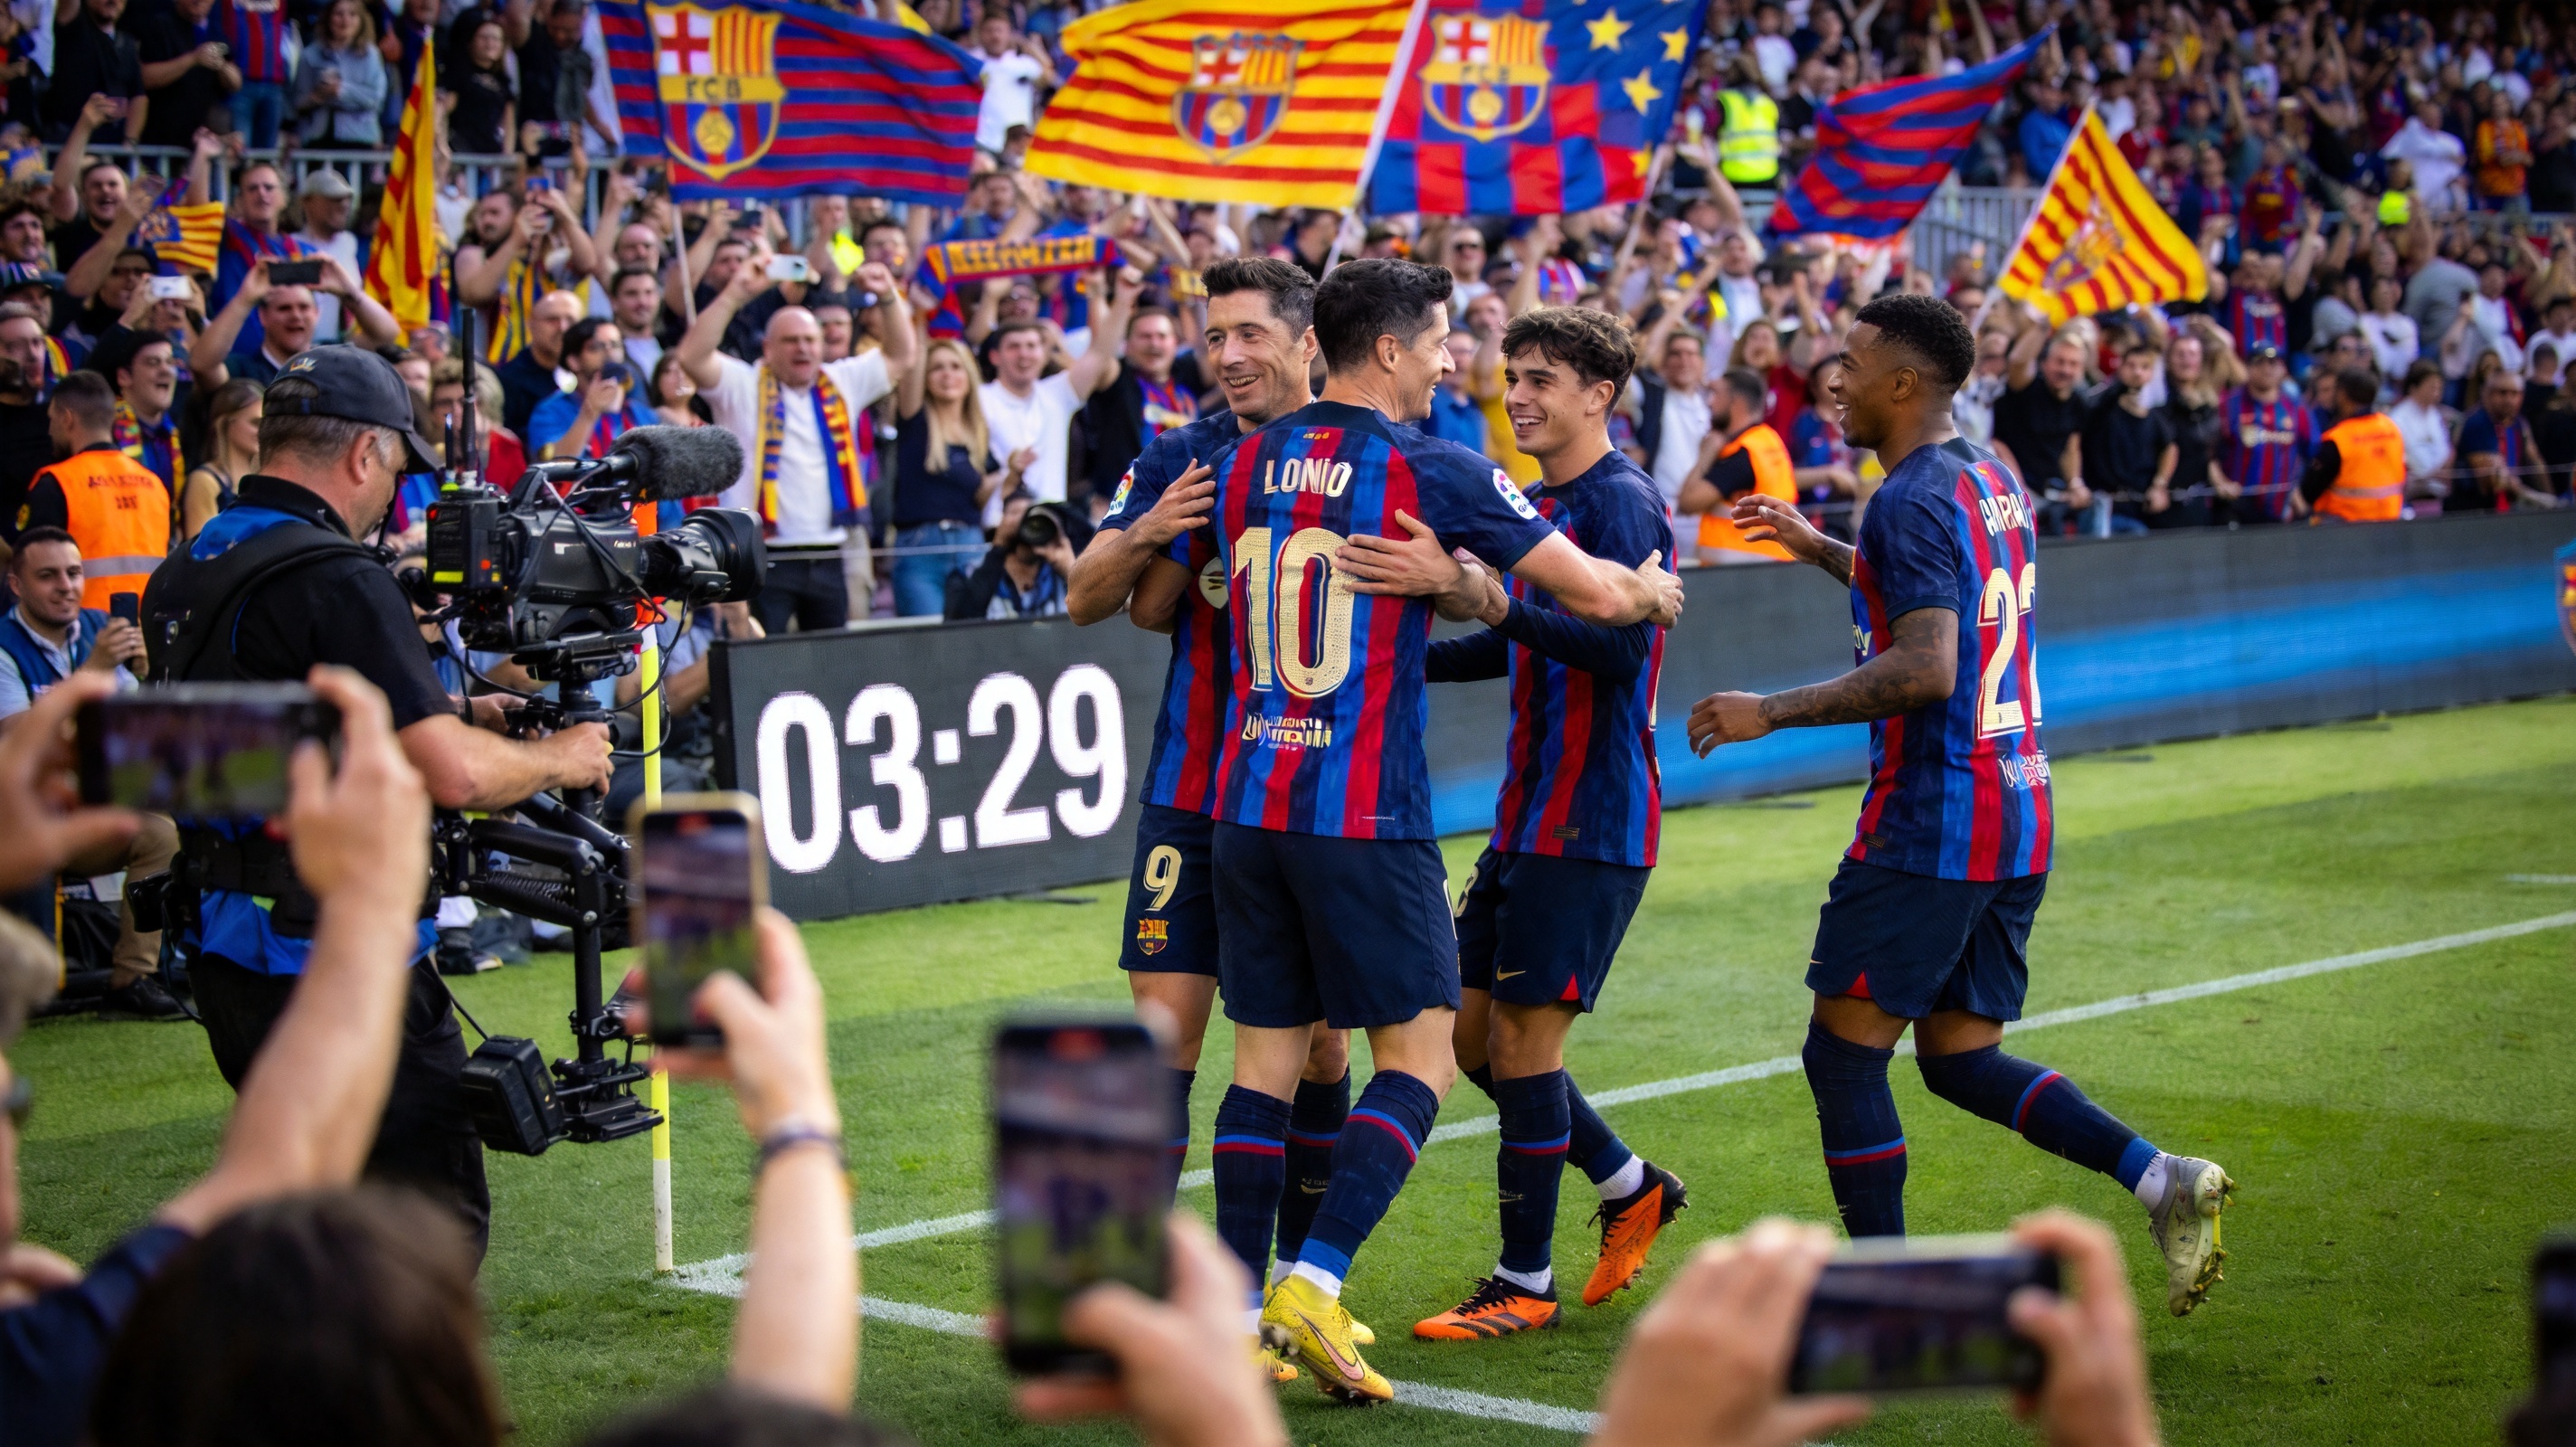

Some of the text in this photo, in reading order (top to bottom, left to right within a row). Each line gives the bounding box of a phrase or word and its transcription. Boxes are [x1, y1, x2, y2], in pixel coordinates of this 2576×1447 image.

[1231, 526, 1355, 697] 10
[756, 663, 1128, 874] 03:29
[1143, 845, 1182, 912] 9
